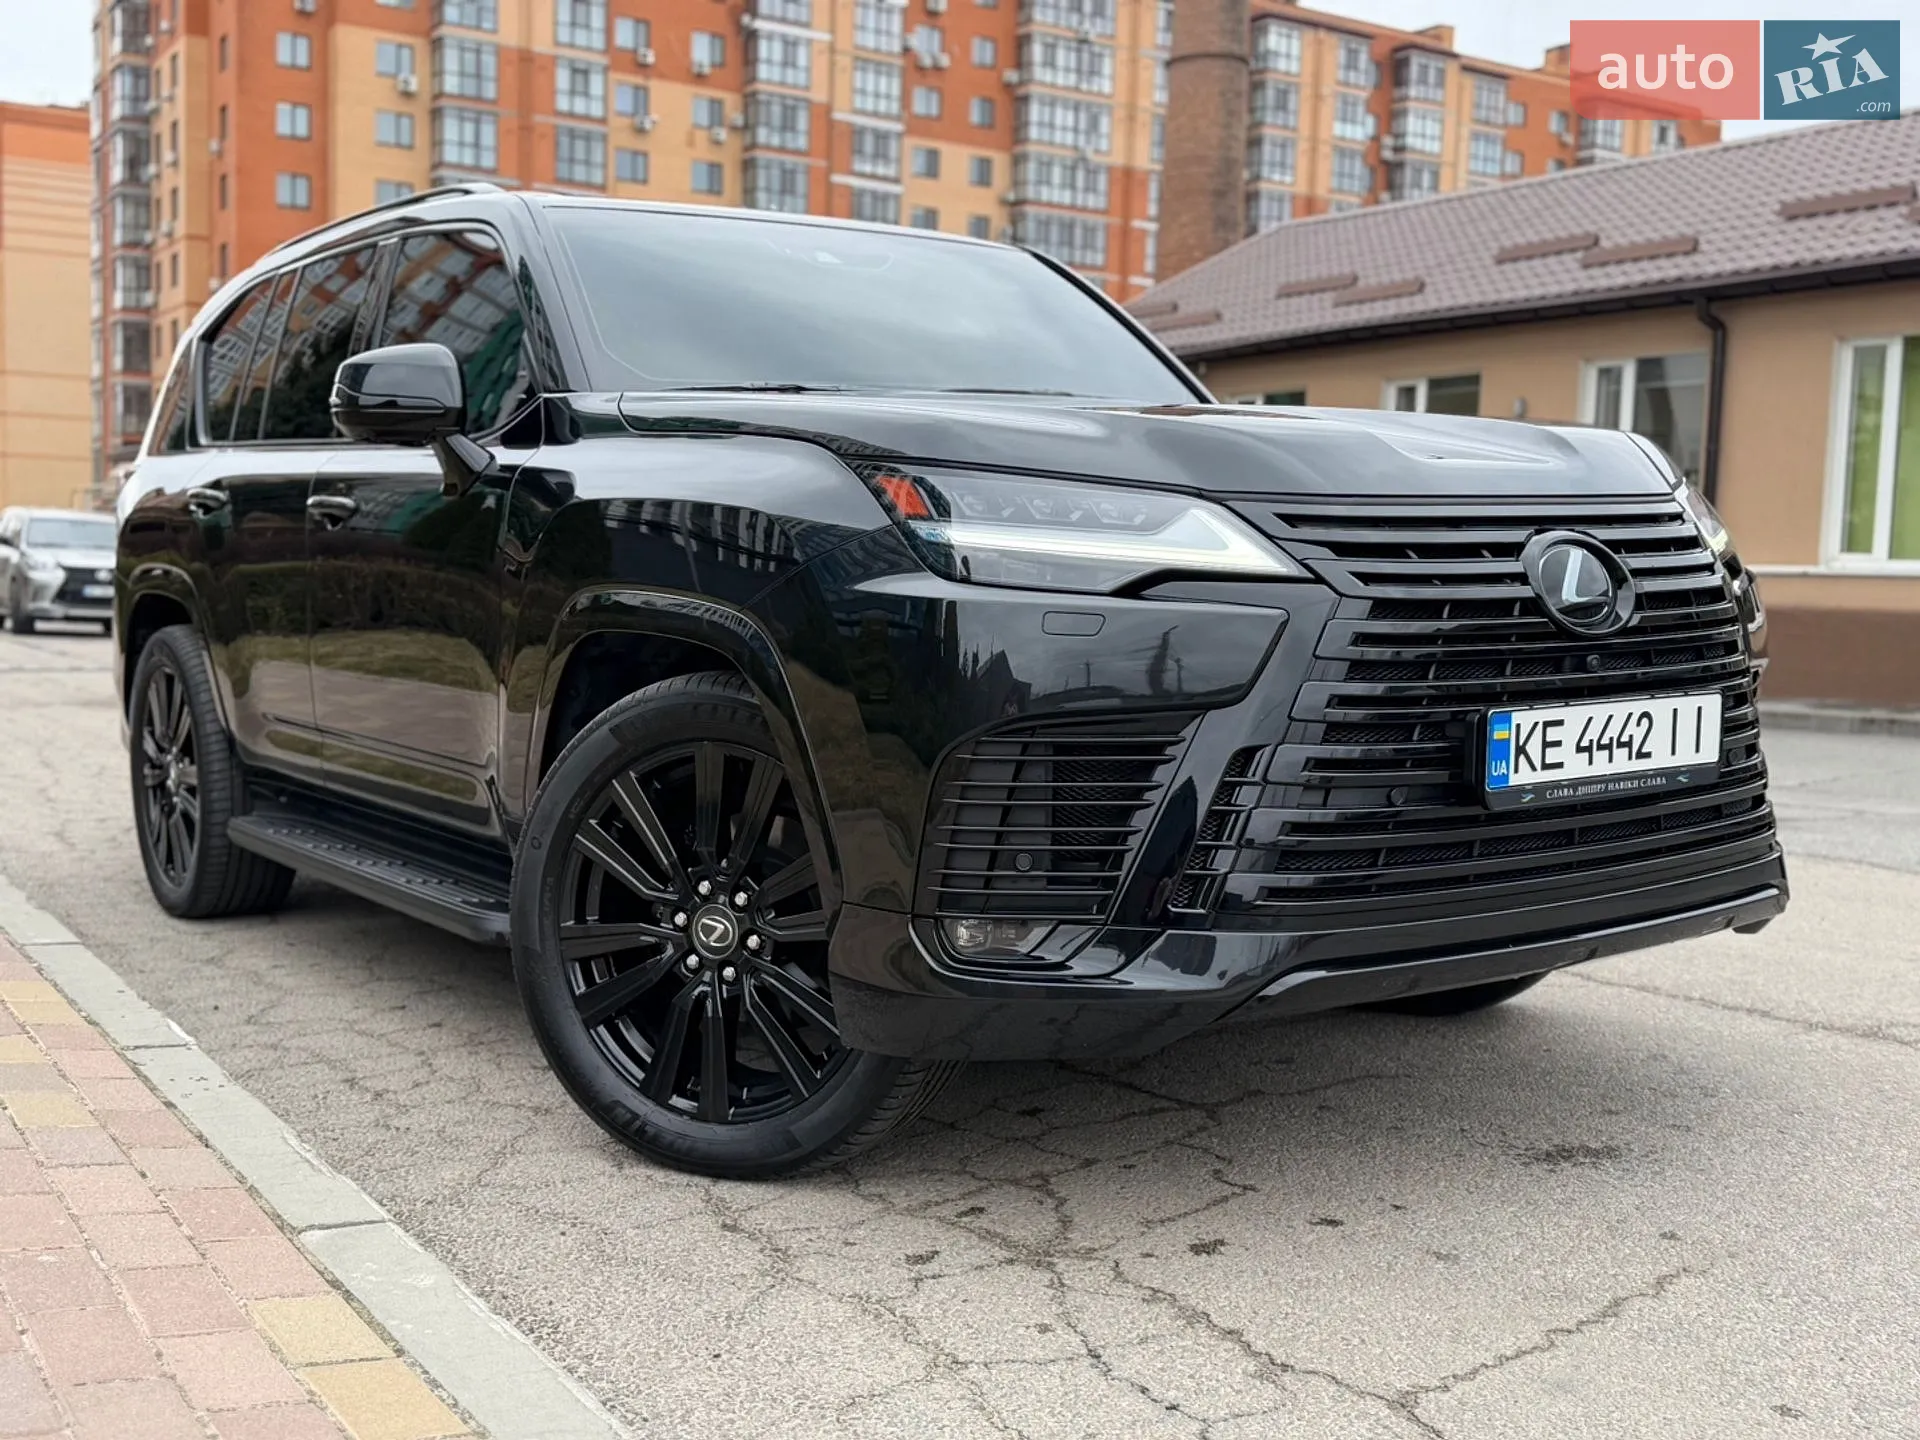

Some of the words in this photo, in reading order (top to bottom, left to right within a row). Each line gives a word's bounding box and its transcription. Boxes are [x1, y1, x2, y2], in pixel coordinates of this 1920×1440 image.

[1513, 718, 1565, 775] KE
[1575, 710, 1654, 767] 4442
[1491, 760, 1508, 776] UA
[1546, 788, 1574, 799] СЛАВА
[1640, 776, 1667, 788] СЛАВА
